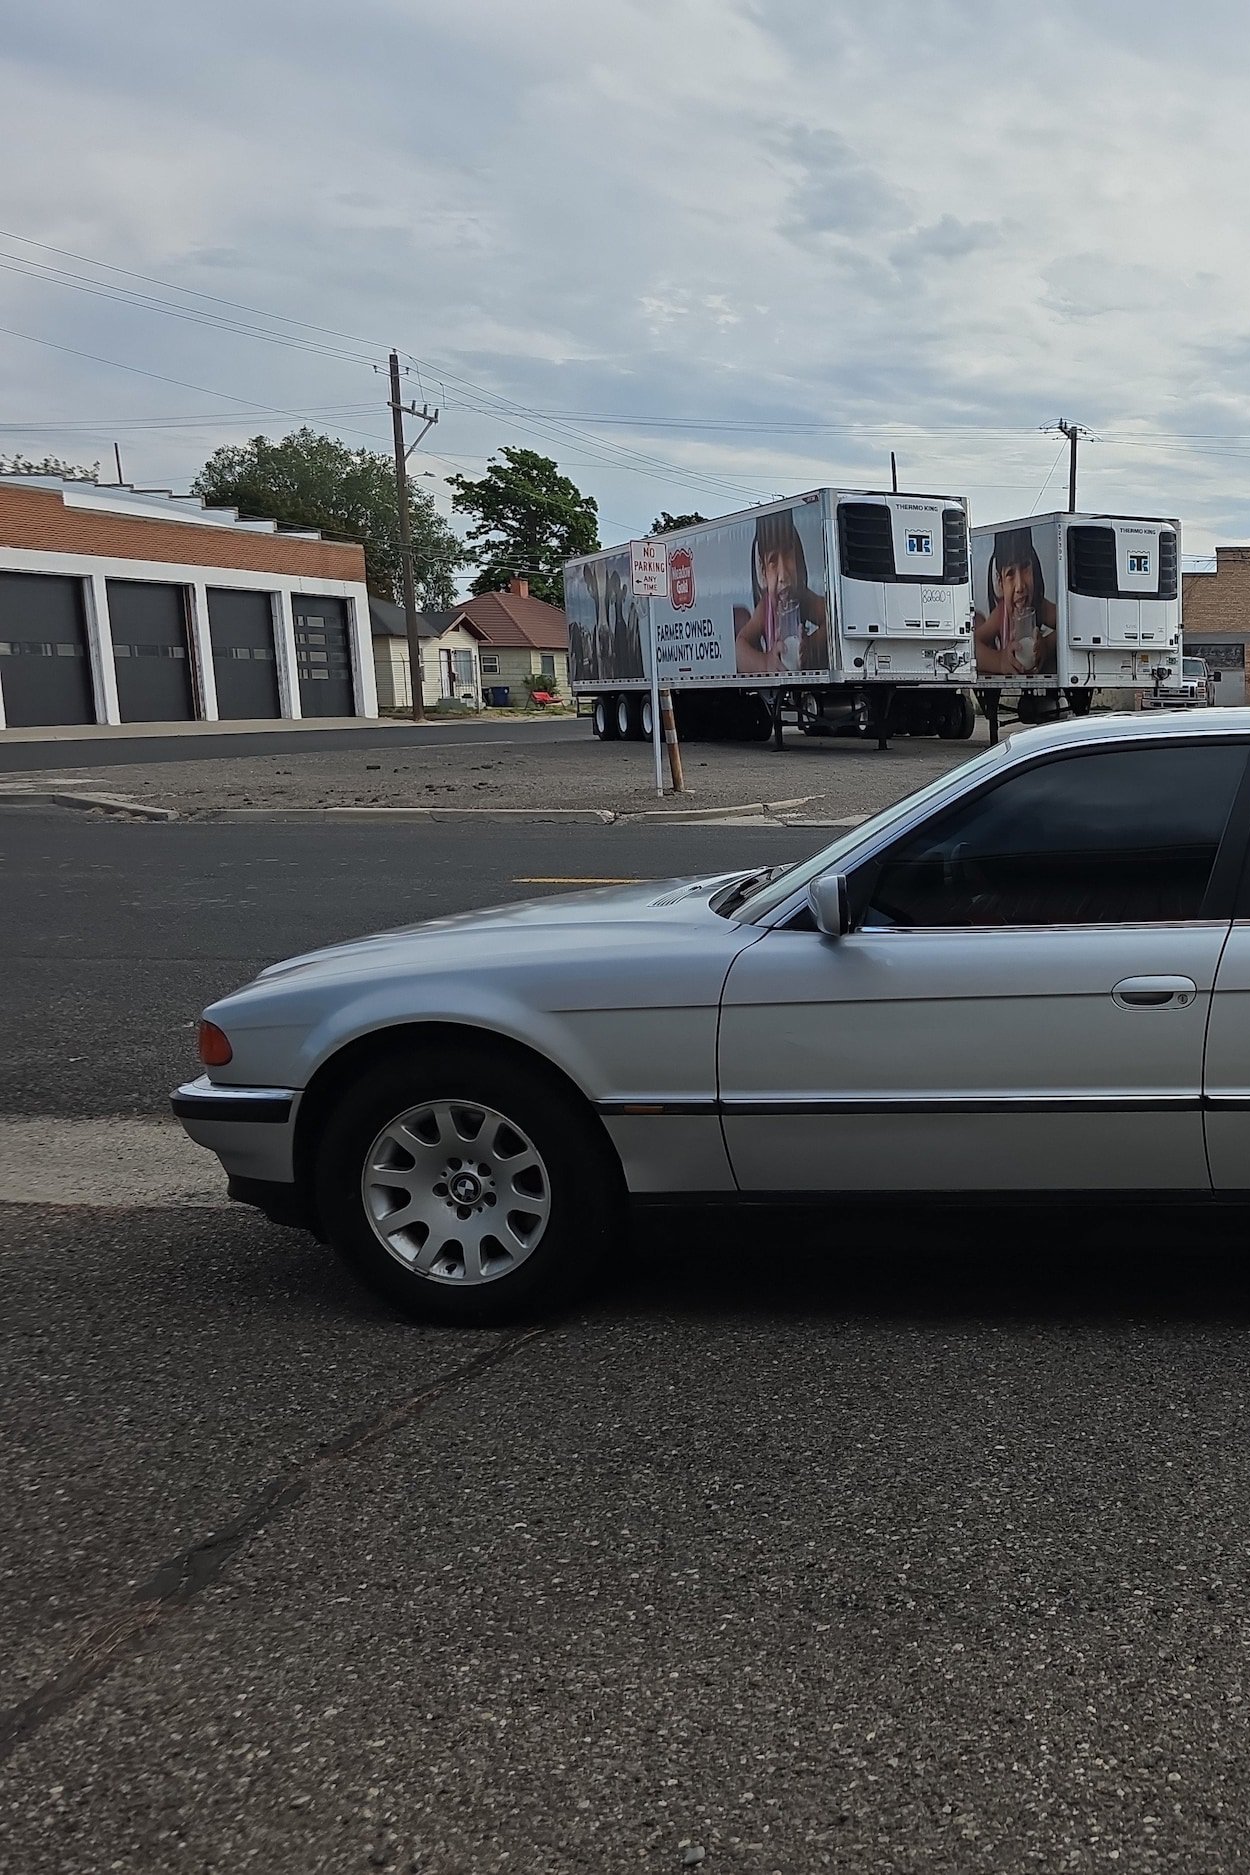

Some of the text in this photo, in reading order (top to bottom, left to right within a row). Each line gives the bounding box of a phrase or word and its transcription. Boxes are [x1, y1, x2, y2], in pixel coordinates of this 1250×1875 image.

[895, 503, 923, 511] THERMO
[643, 547, 655, 558] NO
[634, 561, 665, 573] PARKING
[643, 575, 657, 583] ANY
[643, 583, 658, 591] TIME
[657, 619, 715, 642] FARMER OWNED.
[656, 641, 722, 663] OMMUNITY LOVED.
